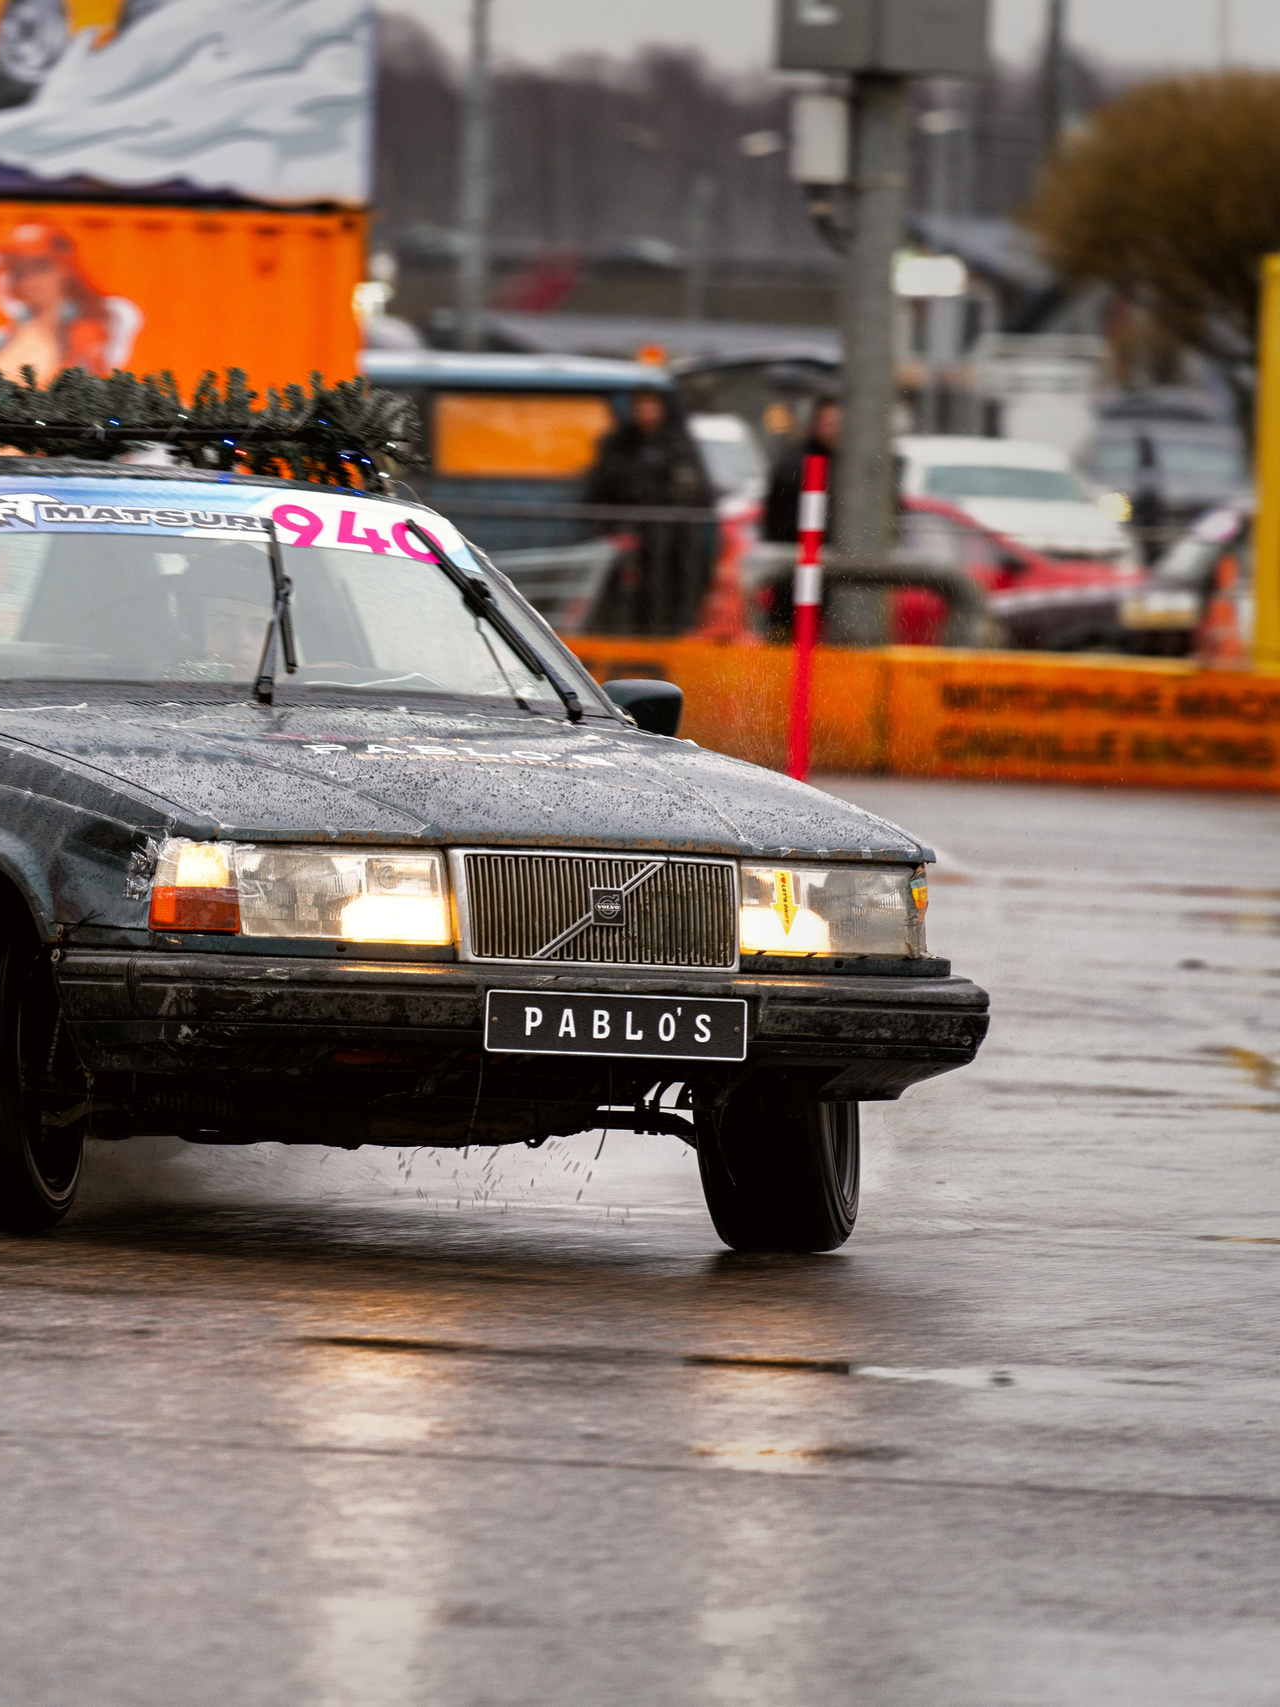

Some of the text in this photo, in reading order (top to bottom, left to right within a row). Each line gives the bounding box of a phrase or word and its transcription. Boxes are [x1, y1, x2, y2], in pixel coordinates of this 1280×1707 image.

[271, 504, 445, 564] 940
[301, 743, 617, 767] PABLO'S
[525, 1006, 712, 1043] PABLO'S
